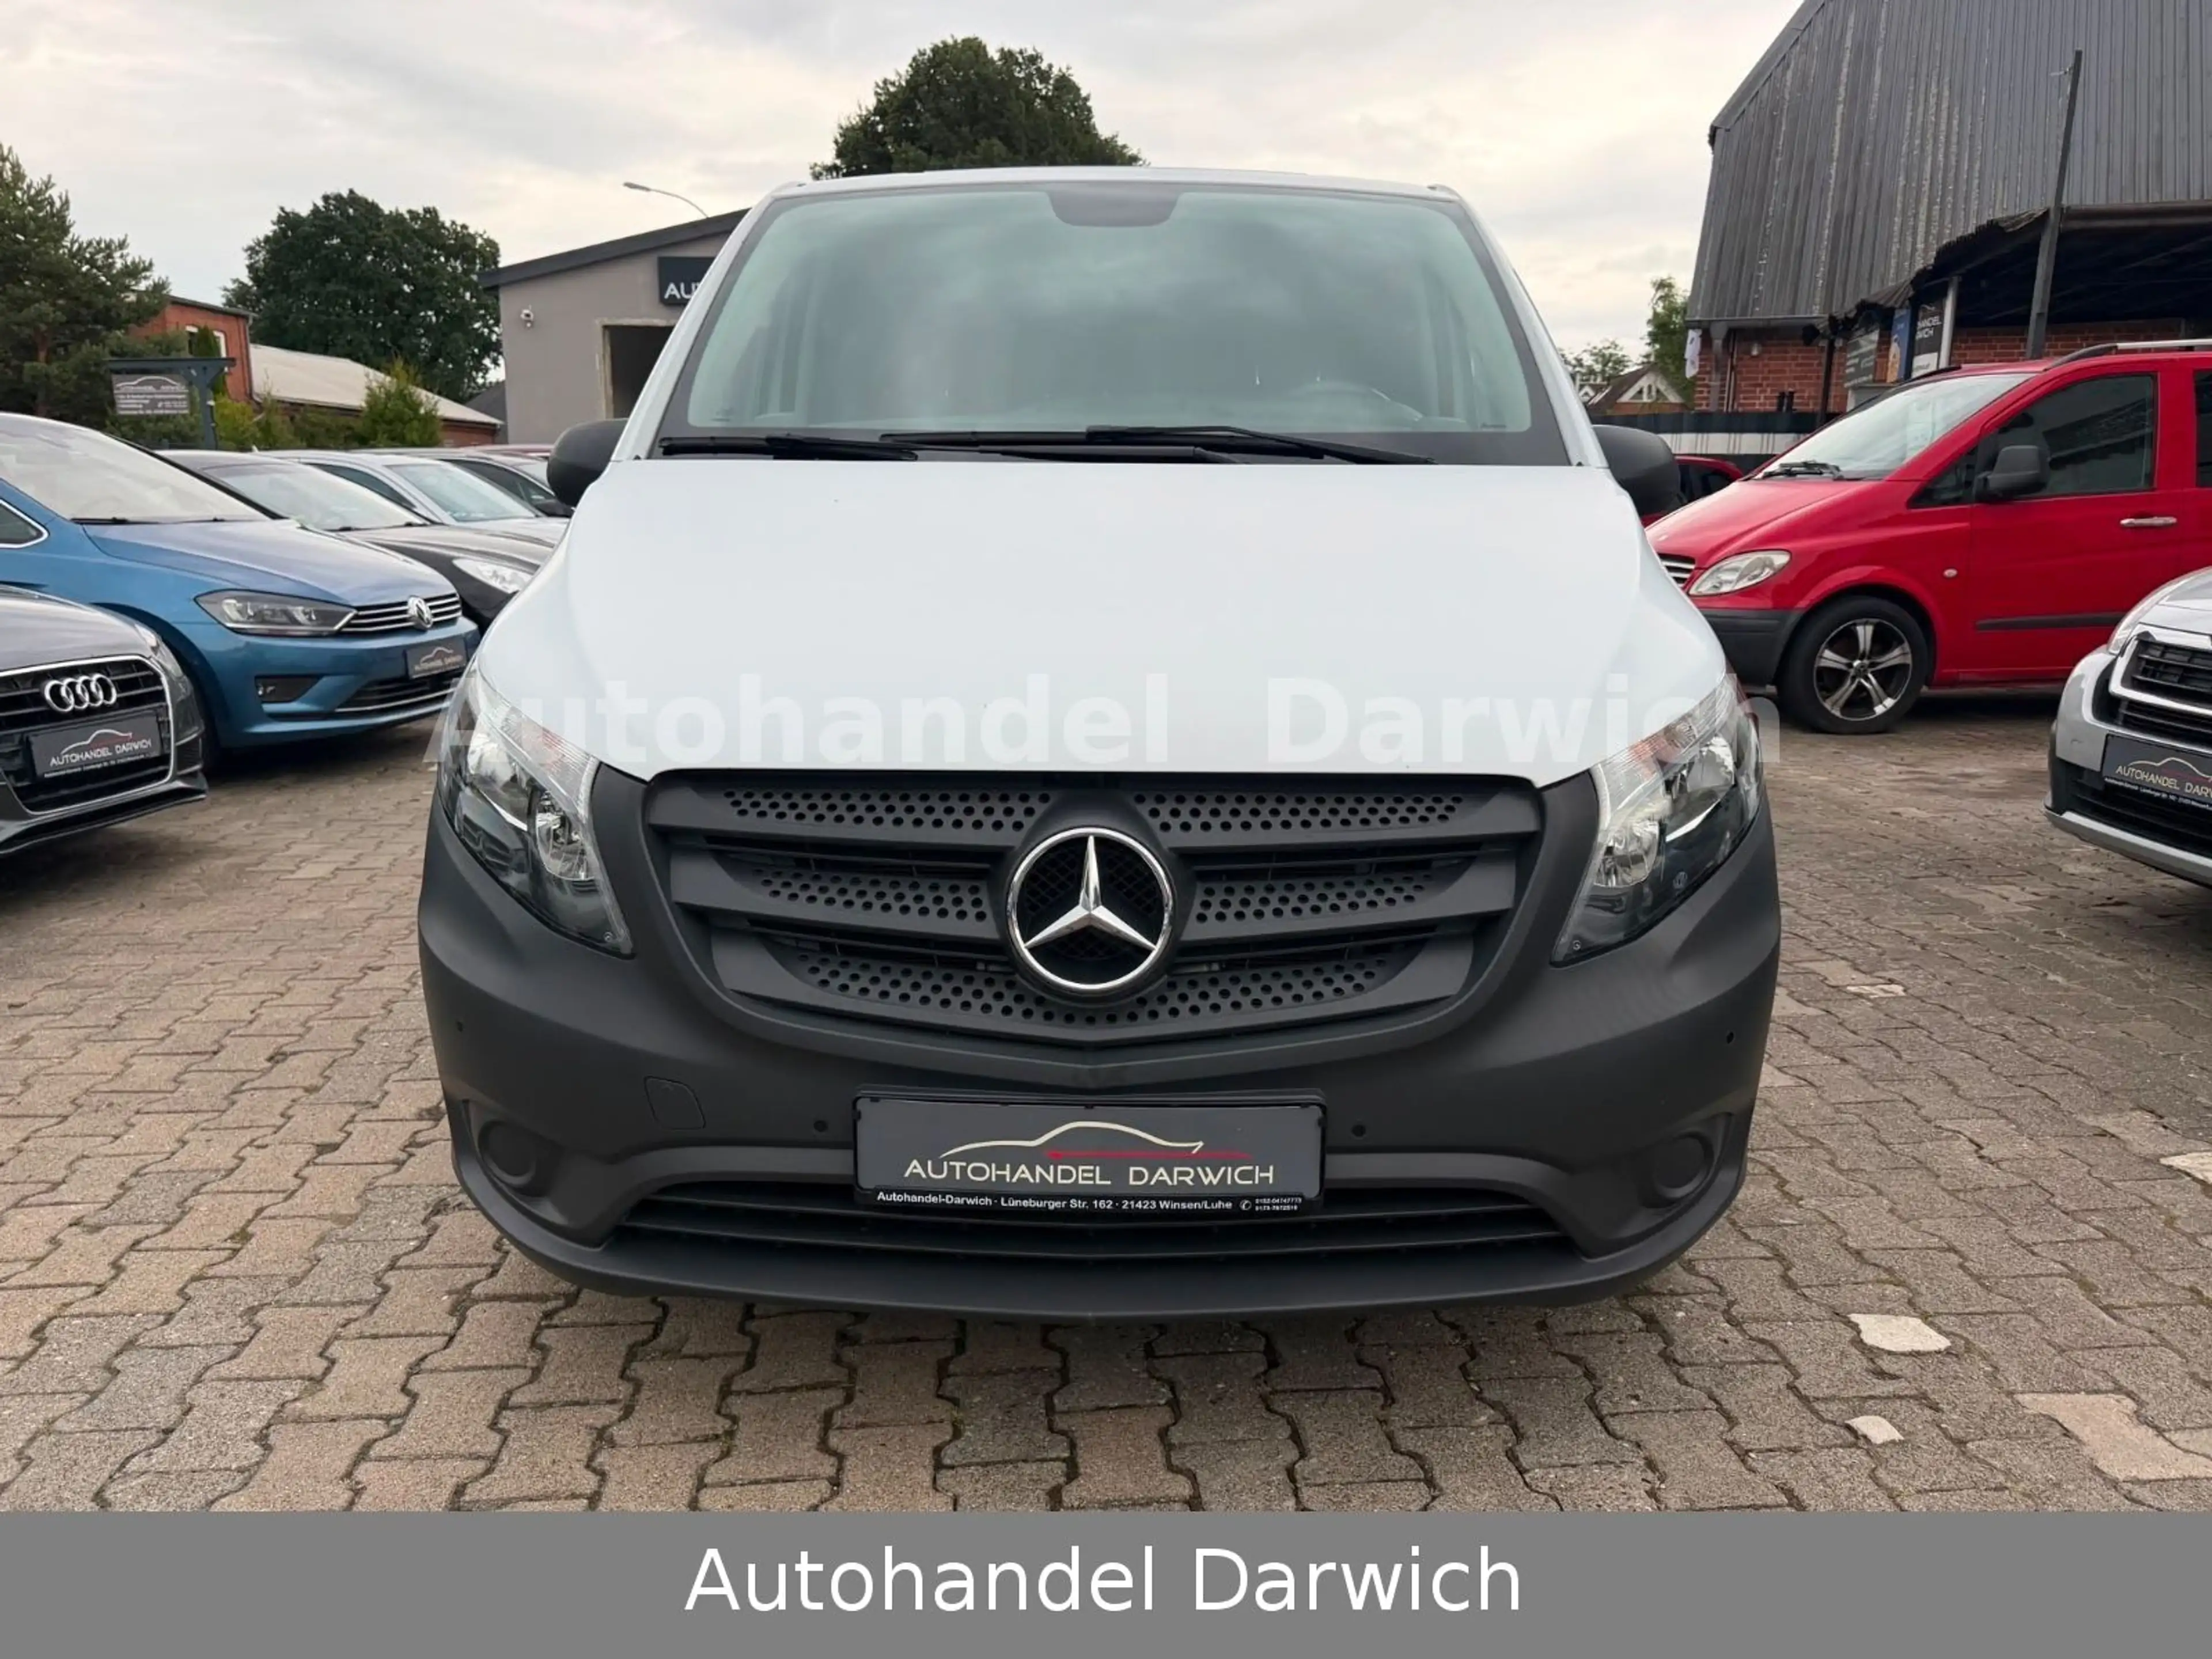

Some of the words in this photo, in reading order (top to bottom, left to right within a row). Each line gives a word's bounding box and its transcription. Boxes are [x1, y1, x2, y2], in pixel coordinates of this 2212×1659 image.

[664, 282, 701, 299] AU
[50, 747, 112, 767] AUTOHANDEL
[2115, 765, 2180, 790] AUTOHANDEL
[2184, 782, 2212, 799] DAR
[904, 1159, 1111, 1185] AUTOHANDEL
[1129, 1165, 1274, 1186] DARWICH
[877, 1191, 992, 1206] Autohandel-Darwich
[1001, 1196, 1066, 1210] Lüneburger
[1070, 1199, 1088, 1209] Str.
[1093, 1199, 1112, 1209] 162
[1122, 1199, 1156, 1210] 21423
[1159, 1200, 1233, 1210] Winsen/Luhe
